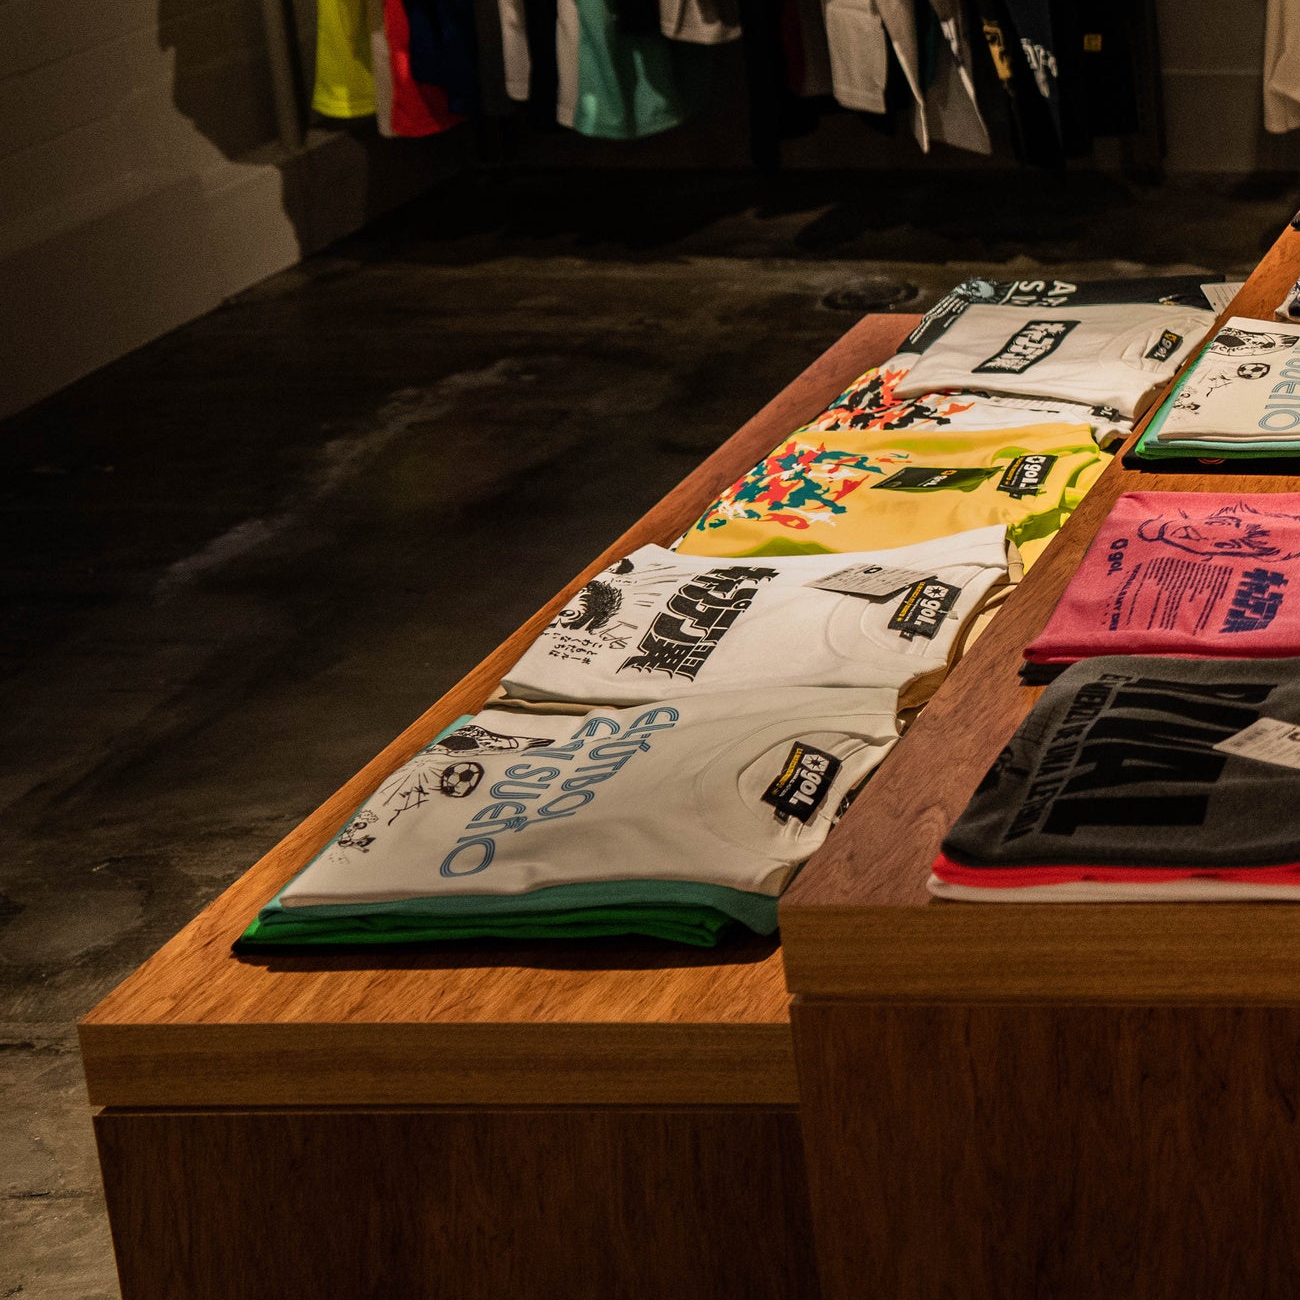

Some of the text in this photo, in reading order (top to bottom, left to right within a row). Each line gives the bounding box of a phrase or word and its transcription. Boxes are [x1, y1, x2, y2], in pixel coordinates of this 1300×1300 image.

[1019, 463, 1042, 490] gol.
[616, 566, 780, 682] キャプテン翼
[913, 598, 942, 626] gol.
[788, 768, 823, 806] gol.
